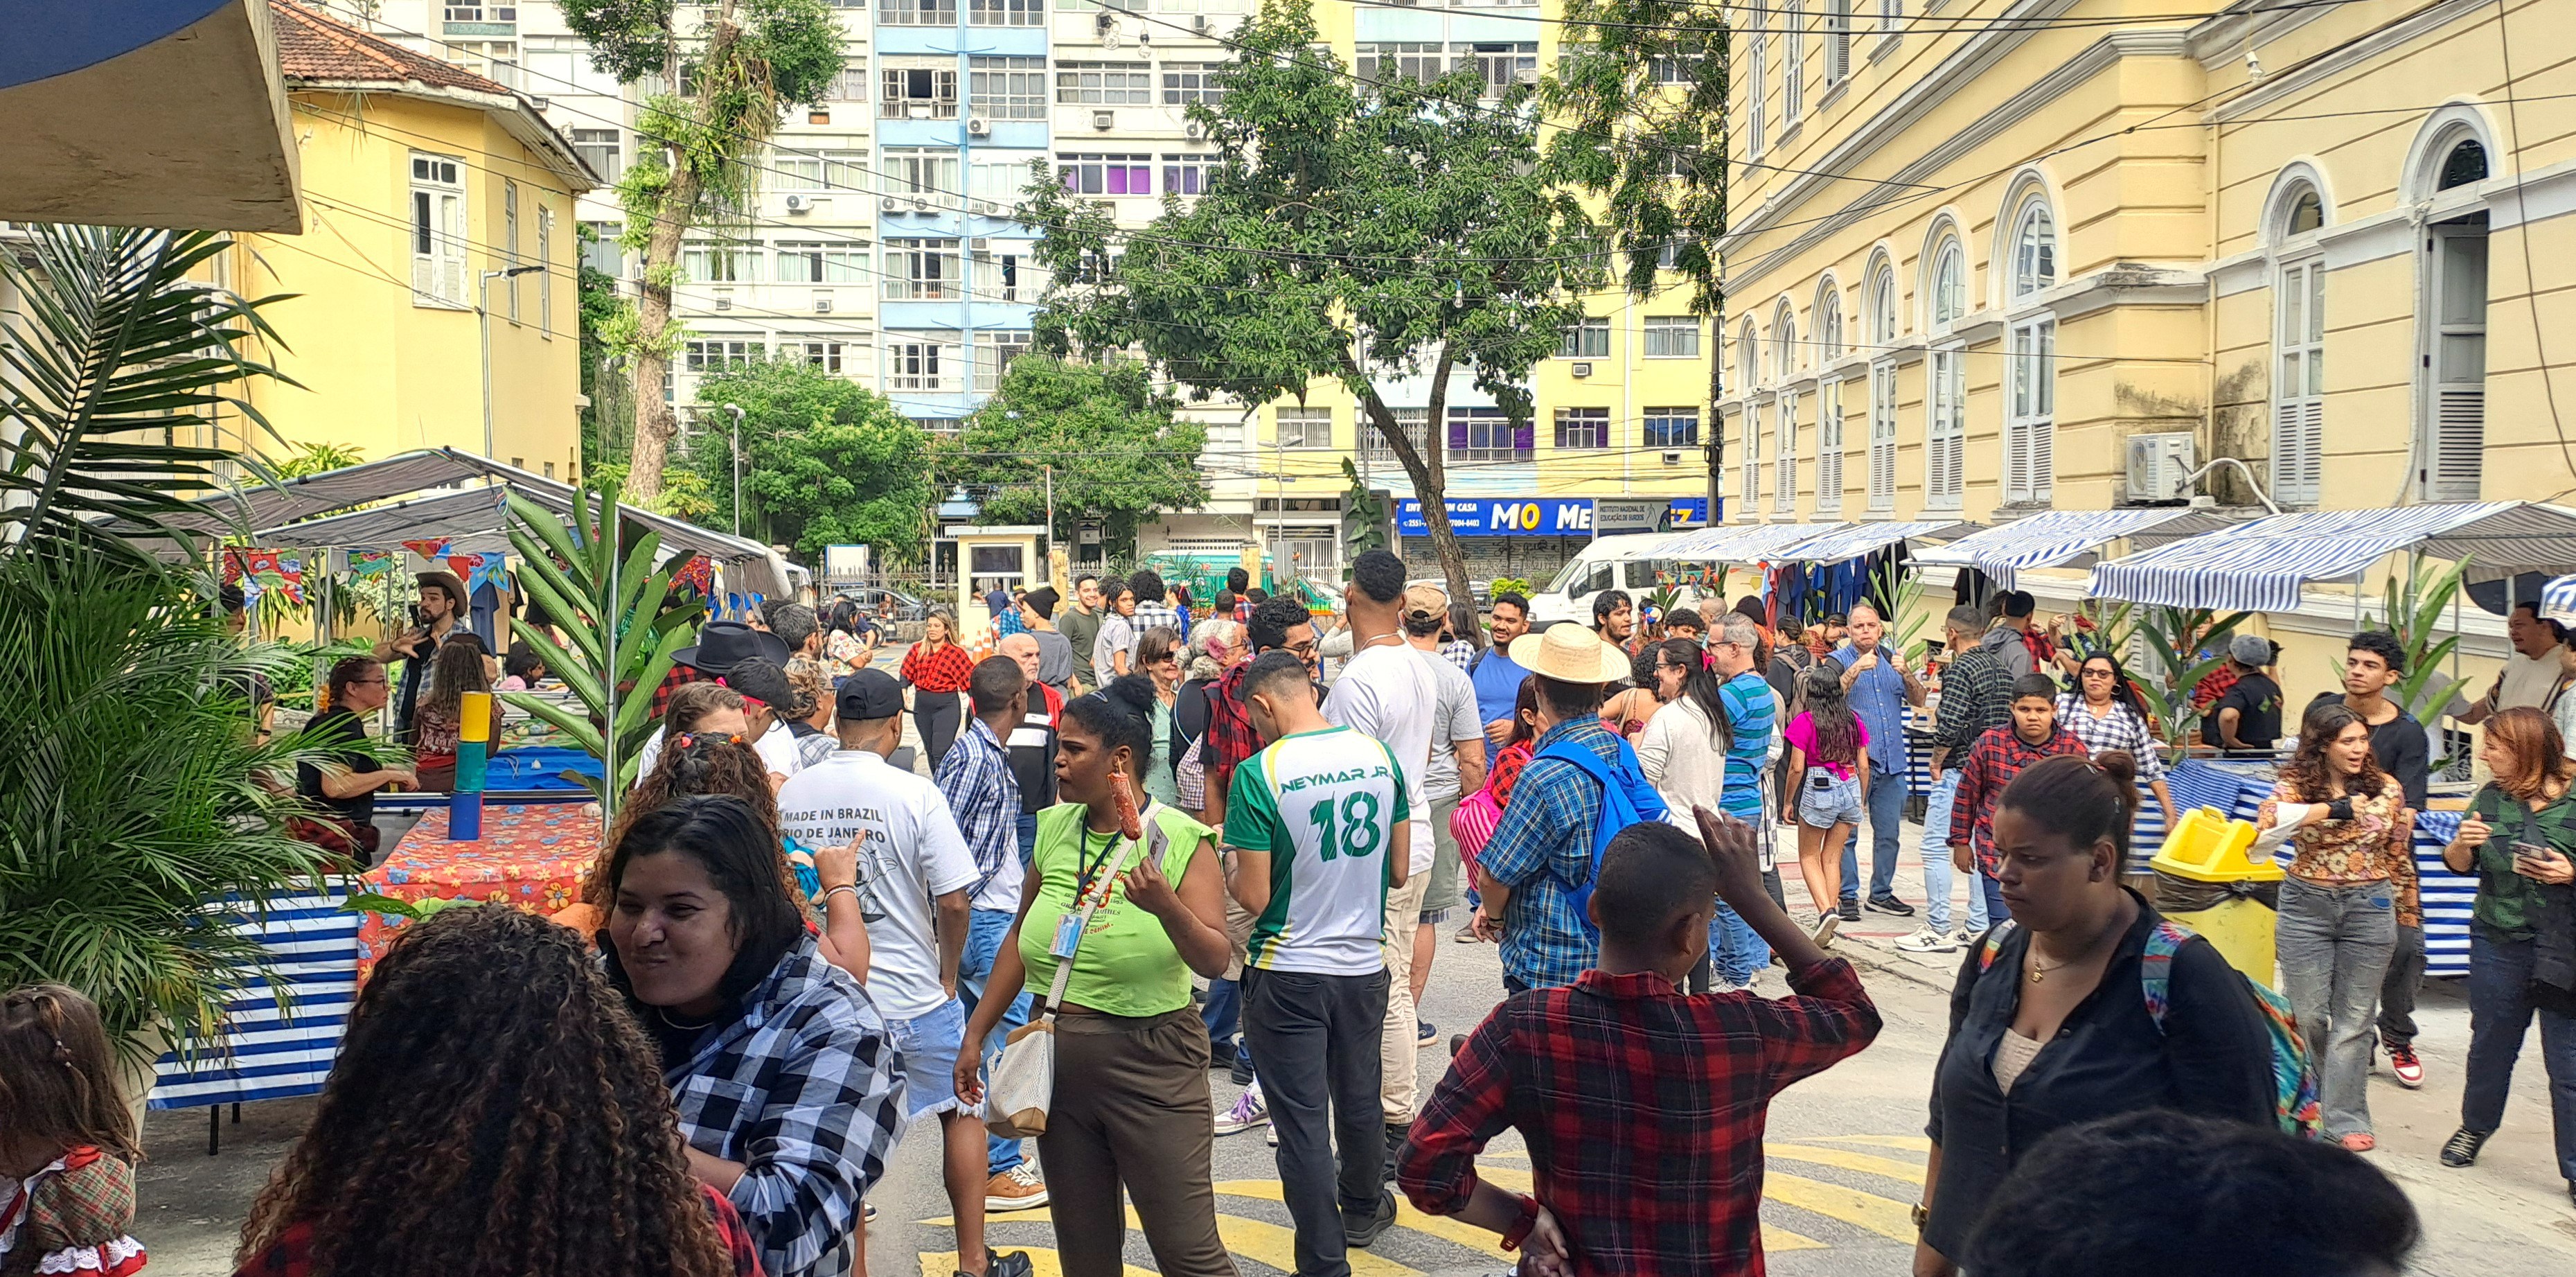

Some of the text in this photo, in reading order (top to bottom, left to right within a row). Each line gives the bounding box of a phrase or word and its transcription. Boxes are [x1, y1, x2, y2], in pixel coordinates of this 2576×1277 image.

[1405, 503, 1421, 511] ENT
[1457, 503, 1477, 511] CASA
[1408, 519, 1426, 527] 2551-
[1491, 503, 1593, 529] MO ME
[1600, 513, 1622, 522] EDUCAÇÃO
[1281, 766, 1389, 793] NEYMAR JR
[784, 808, 884, 822] MADE IN BRAZIL
[1310, 791, 1380, 862] 18
[783, 827, 886, 843] RIO DE JANERO
